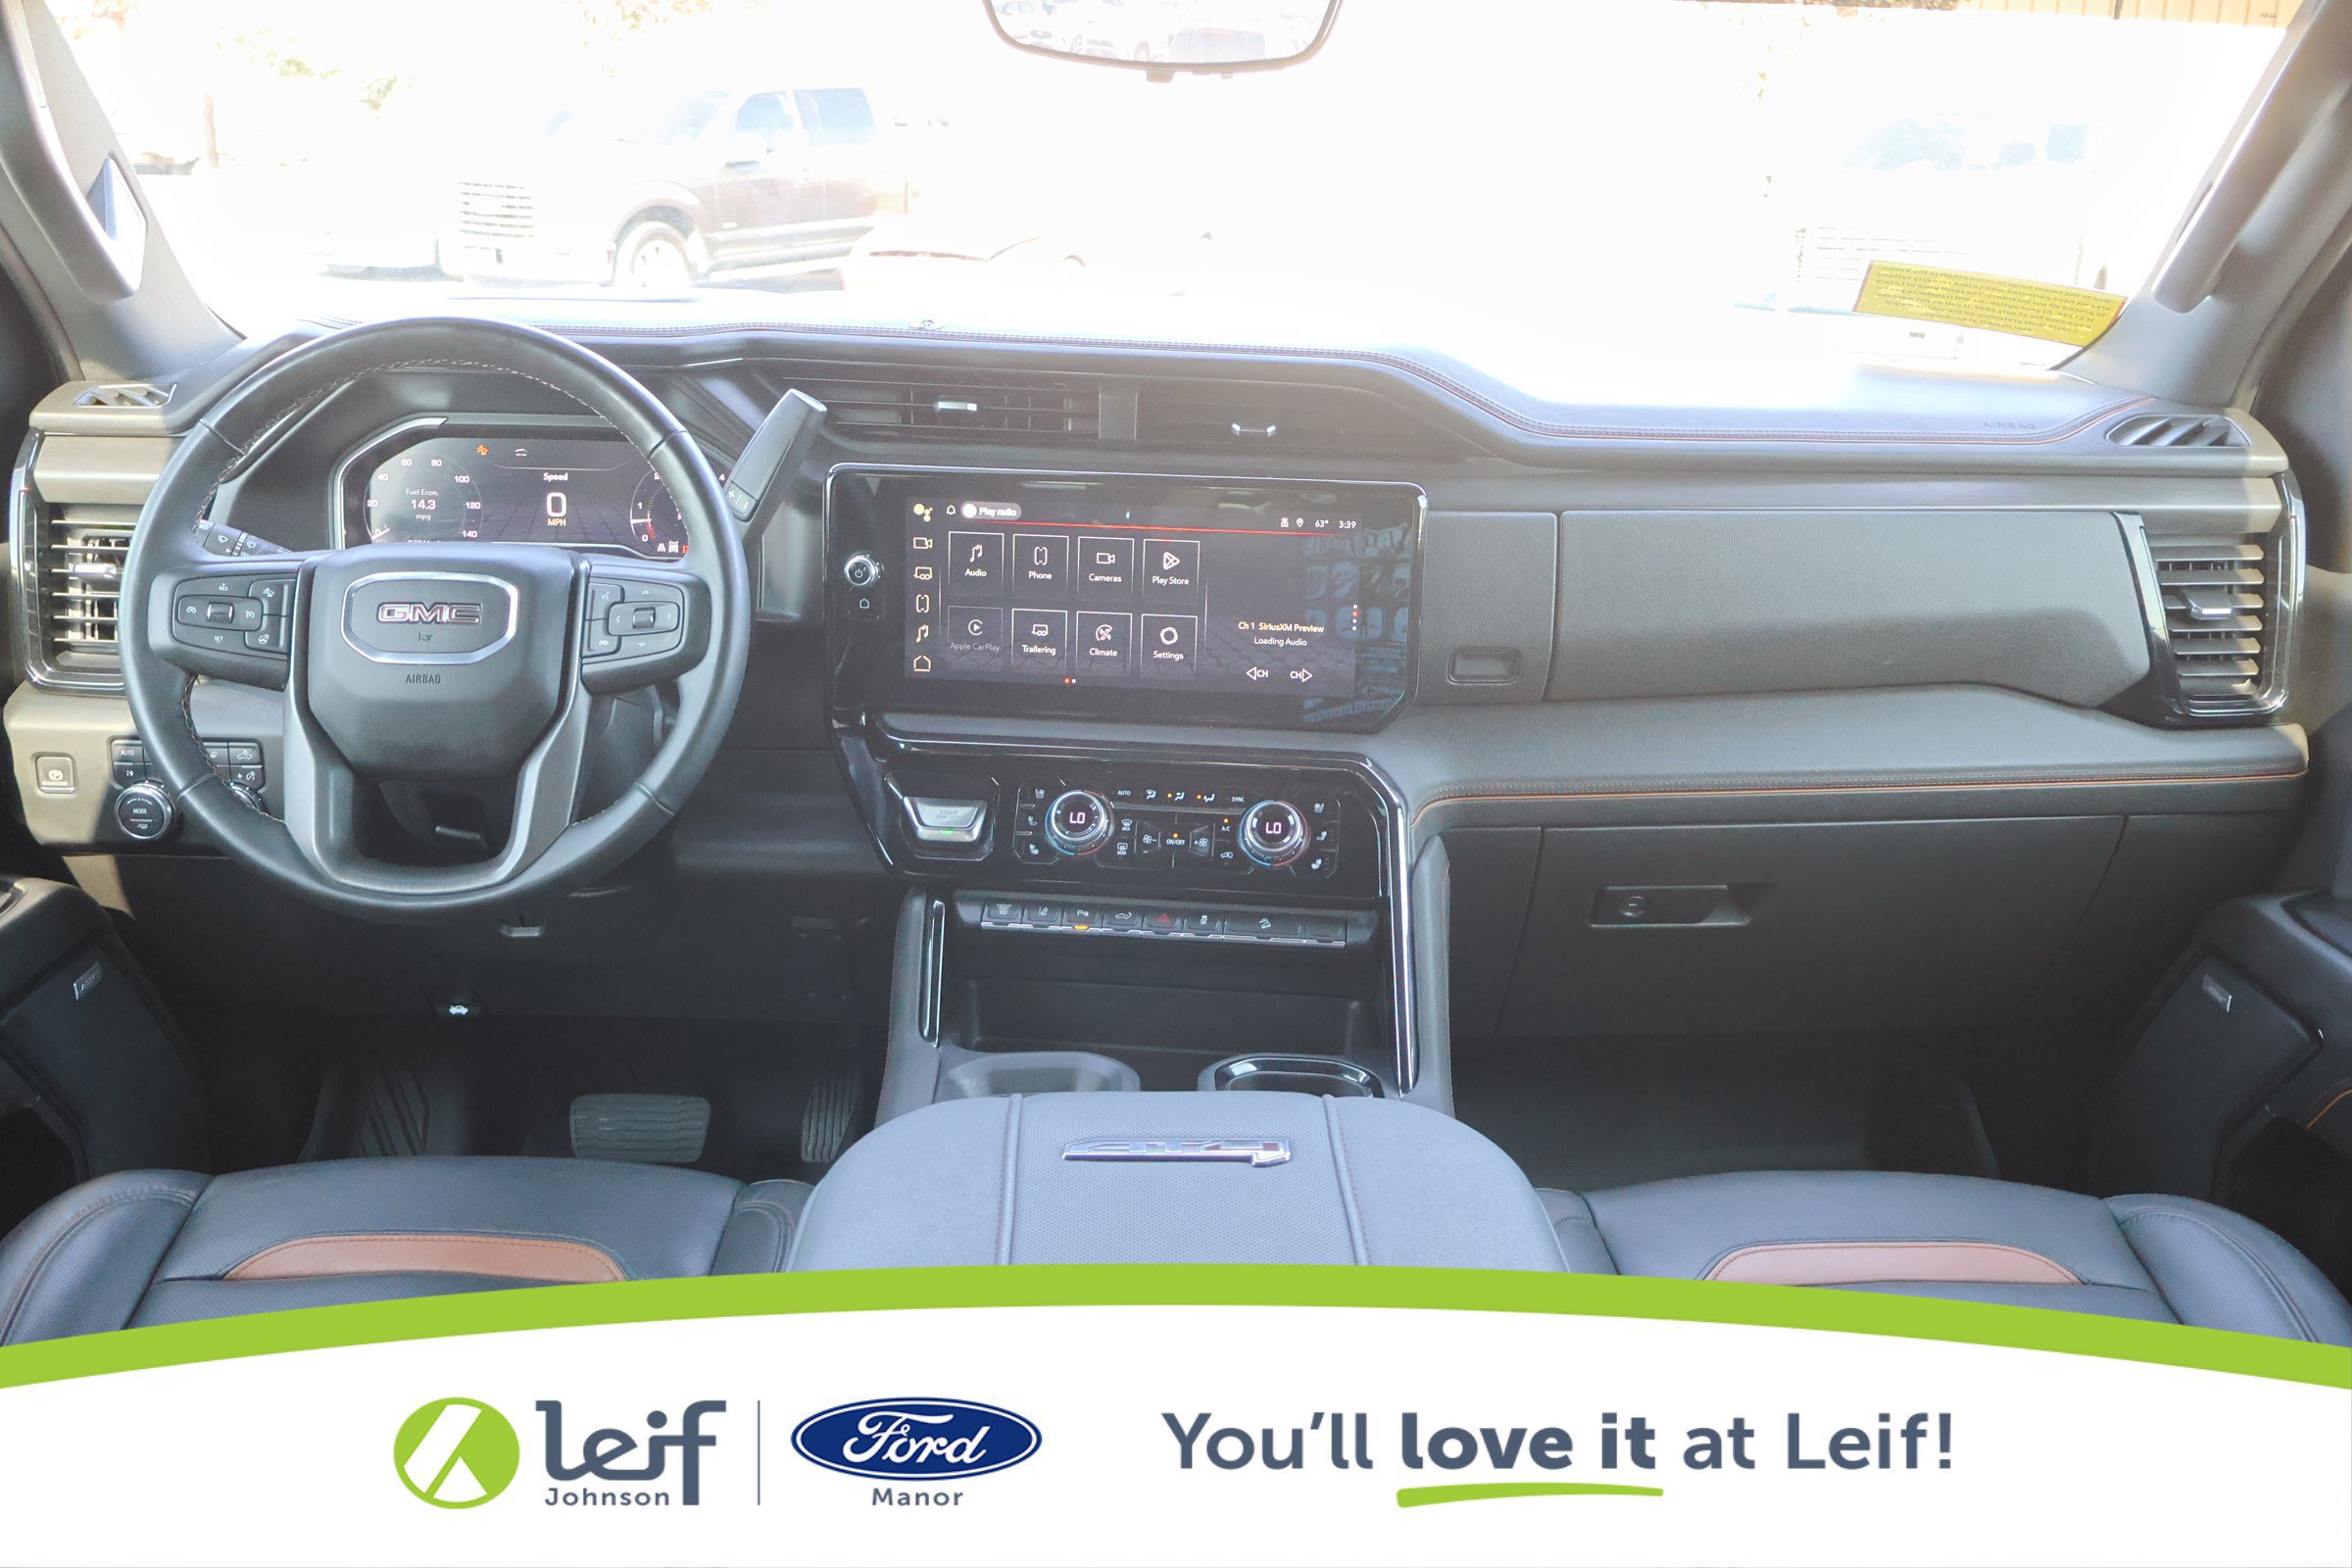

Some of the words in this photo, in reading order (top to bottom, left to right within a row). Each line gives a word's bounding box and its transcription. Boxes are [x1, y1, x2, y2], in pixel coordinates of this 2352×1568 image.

[543, 471, 568, 482] Speed
[411, 499, 436, 510] 14.3
[546, 492, 567, 517] 0
[979, 507, 996, 516] Play
[997, 508, 1017, 516] radio
[547, 517, 566, 526] MPH
[1338, 520, 1356, 529] 3:39
[964, 568, 987, 577] Audio
[1028, 571, 1053, 580] Phone
[1089, 573, 1122, 583] Cameras
[1152, 576, 1168, 585] Play
[1169, 576, 1189, 585] Store
[377, 601, 481, 623] GMC
[1238, 621, 1249, 630] Ch
[1258, 622, 1293, 631] SiriusXM
[1294, 623, 1324, 633] Preview
[1253, 637, 1284, 647] Loading
[1285, 637, 1307, 647] Audio
[950, 642, 971, 653] Apple
[972, 643, 1001, 654] CarPlay
[1022, 645, 1056, 656] Trailering
[1089, 648, 1118, 657] Climate
[1152, 651, 1184, 661] Settings
[406, 674, 441, 684] AIRBAG
[1069, 811, 1086, 824] LO
[1265, 821, 1282, 834] LO
